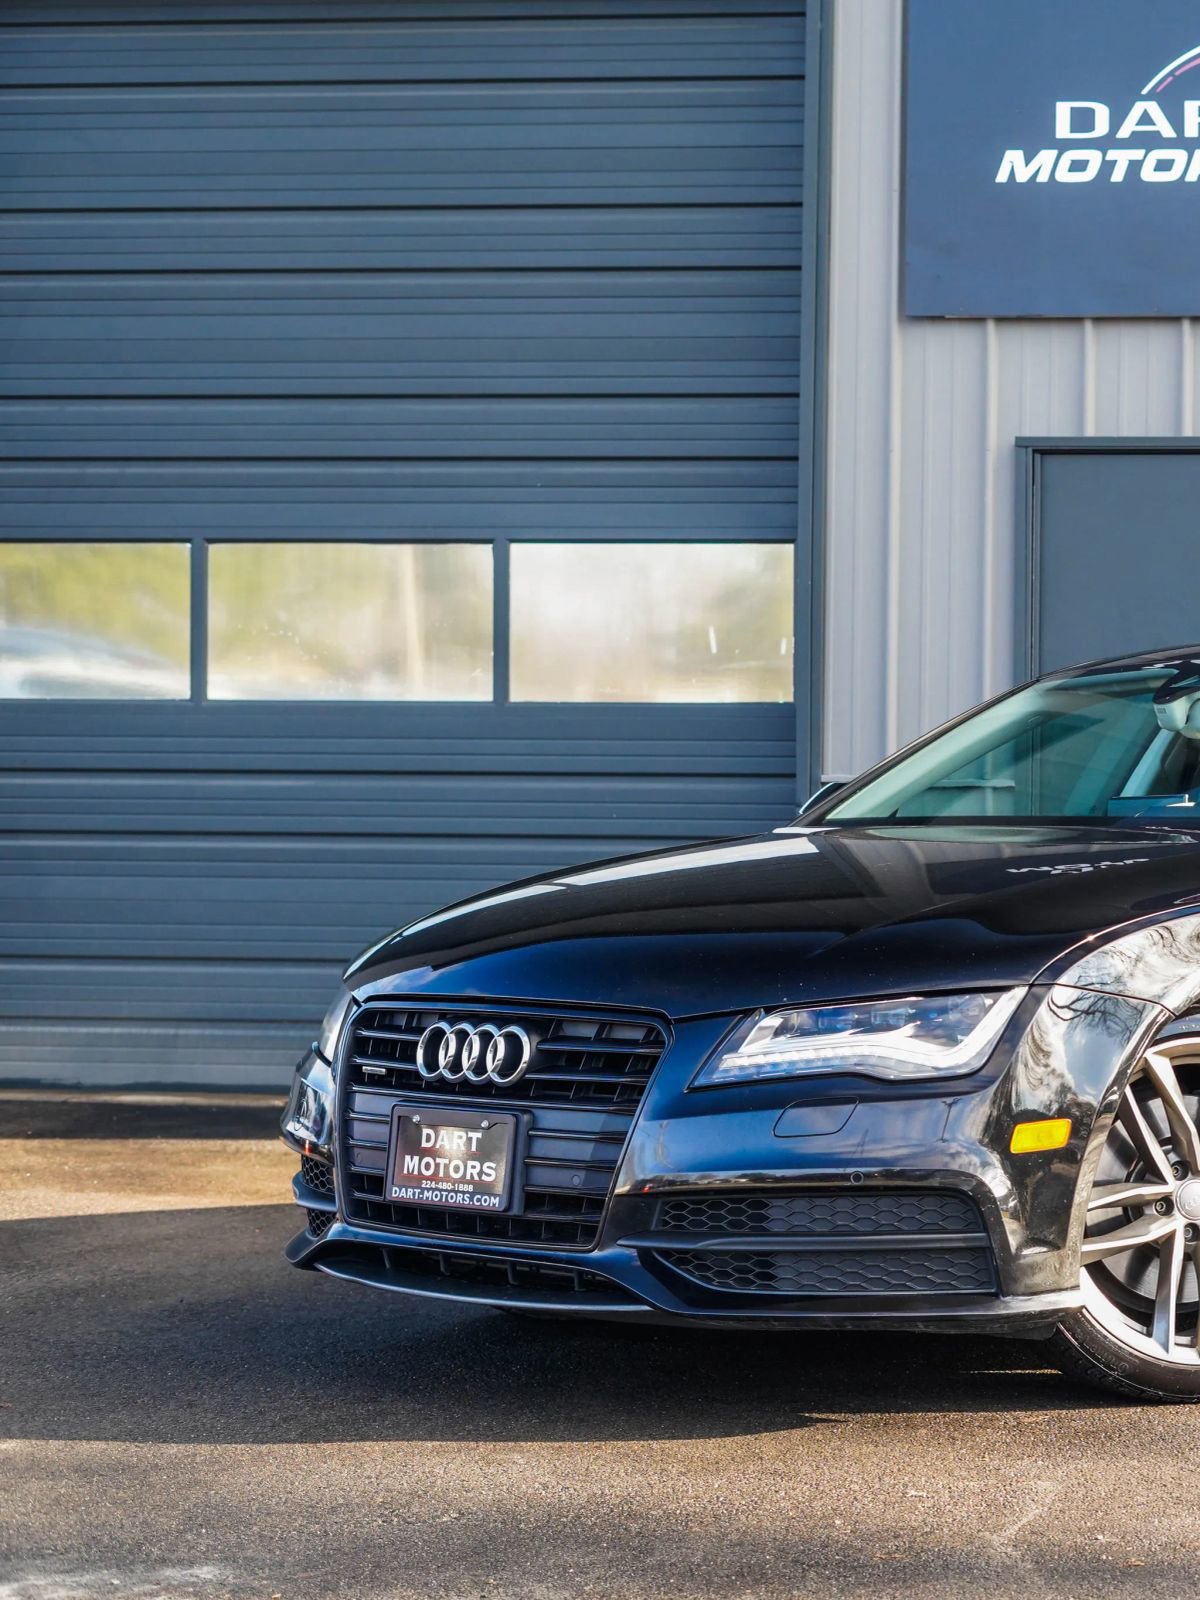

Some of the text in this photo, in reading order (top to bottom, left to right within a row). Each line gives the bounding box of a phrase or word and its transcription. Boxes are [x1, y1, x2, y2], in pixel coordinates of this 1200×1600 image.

[421, 1128, 482, 1152] DART
[403, 1155, 497, 1182] MOTORS
[391, 1187, 500, 1207] DART-MOTORS.COM
